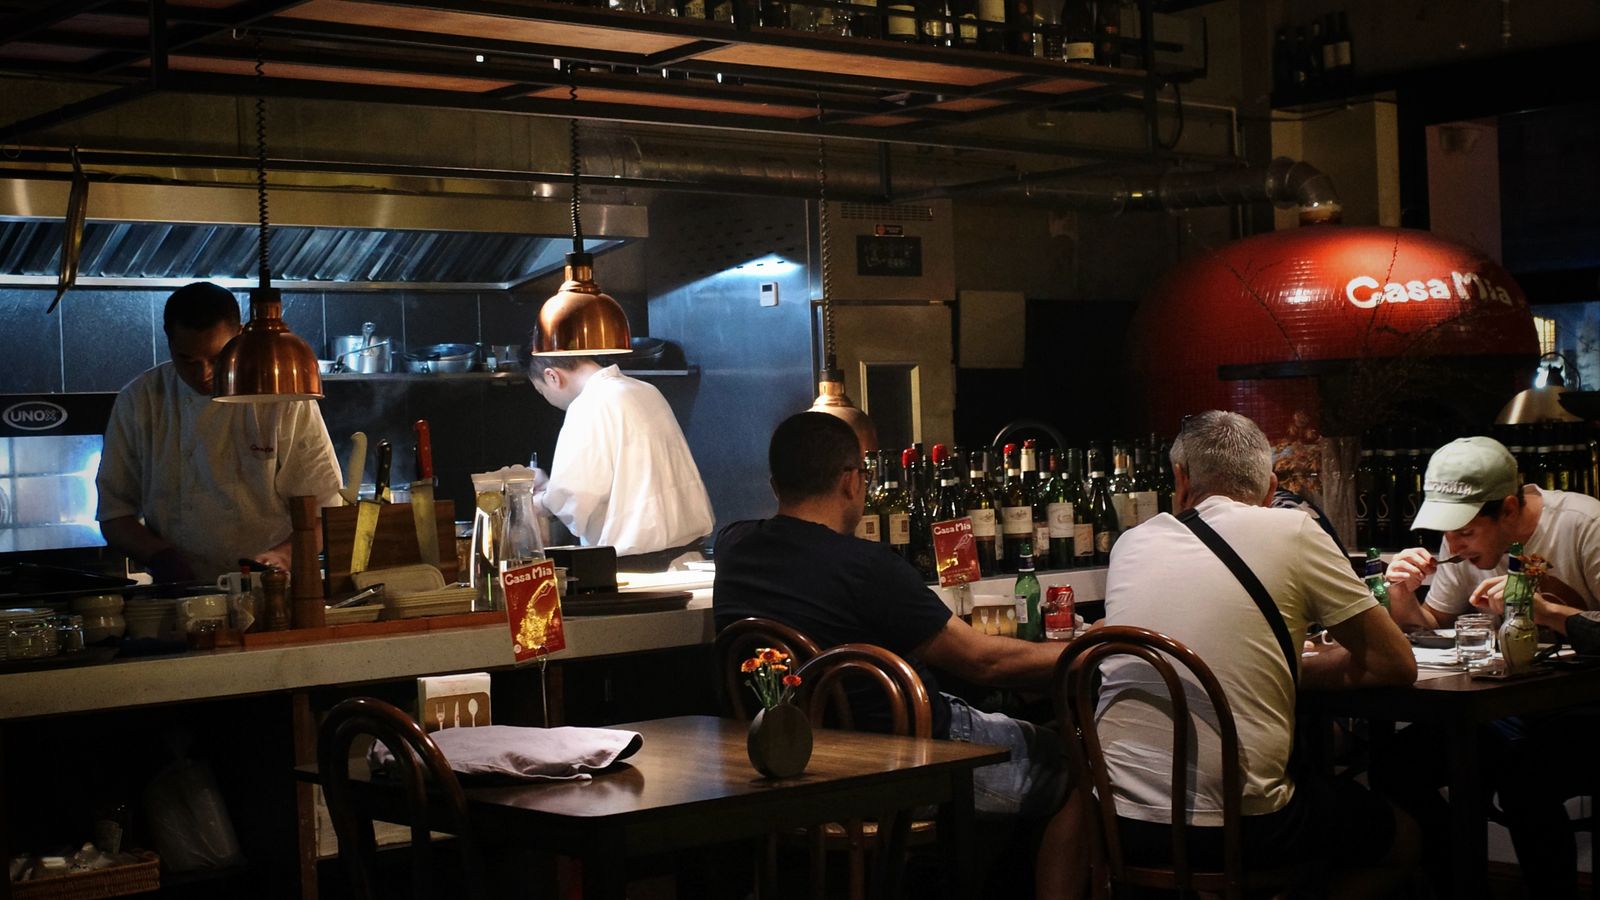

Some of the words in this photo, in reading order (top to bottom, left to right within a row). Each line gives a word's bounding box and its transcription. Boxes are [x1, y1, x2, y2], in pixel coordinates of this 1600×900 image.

[1346, 276, 1451, 309] Casa
[1451, 271, 1513, 306] Mia
[10, 410, 57, 422] UNOX
[934, 526, 955, 535] Casa
[955, 522, 972, 532] Mia
[504, 573, 532, 586] Casa
[532, 566, 553, 580] Mia
